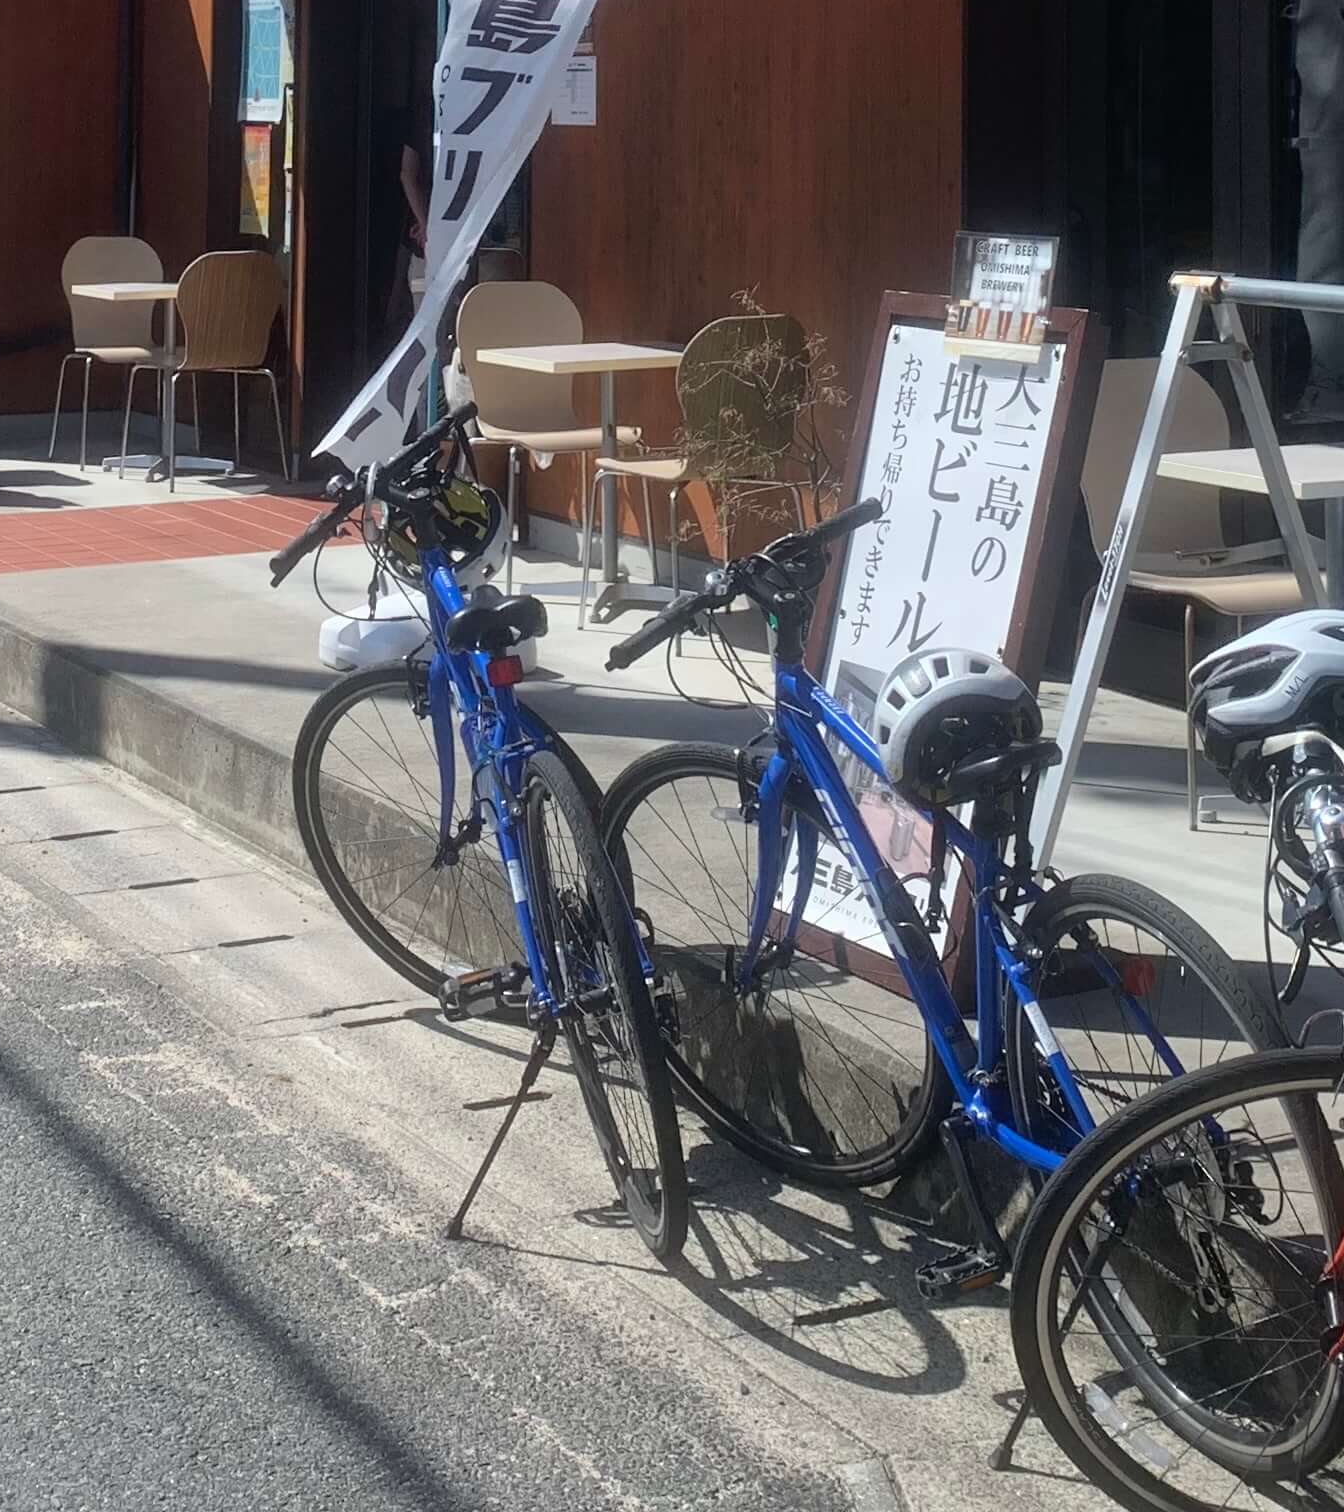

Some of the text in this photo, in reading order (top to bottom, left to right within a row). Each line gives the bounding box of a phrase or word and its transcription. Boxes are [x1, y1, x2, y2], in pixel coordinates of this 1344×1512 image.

[975, 239, 1040, 257] CRAFT BEER
[980, 262, 1031, 277] OMISHIMA
[980, 278, 1025, 294] BREWERY
[850, 352, 923, 646] お持ち帰りできます
[885, 361, 990, 653] 地ビール
[971, 364, 1047, 583] 大三島の
